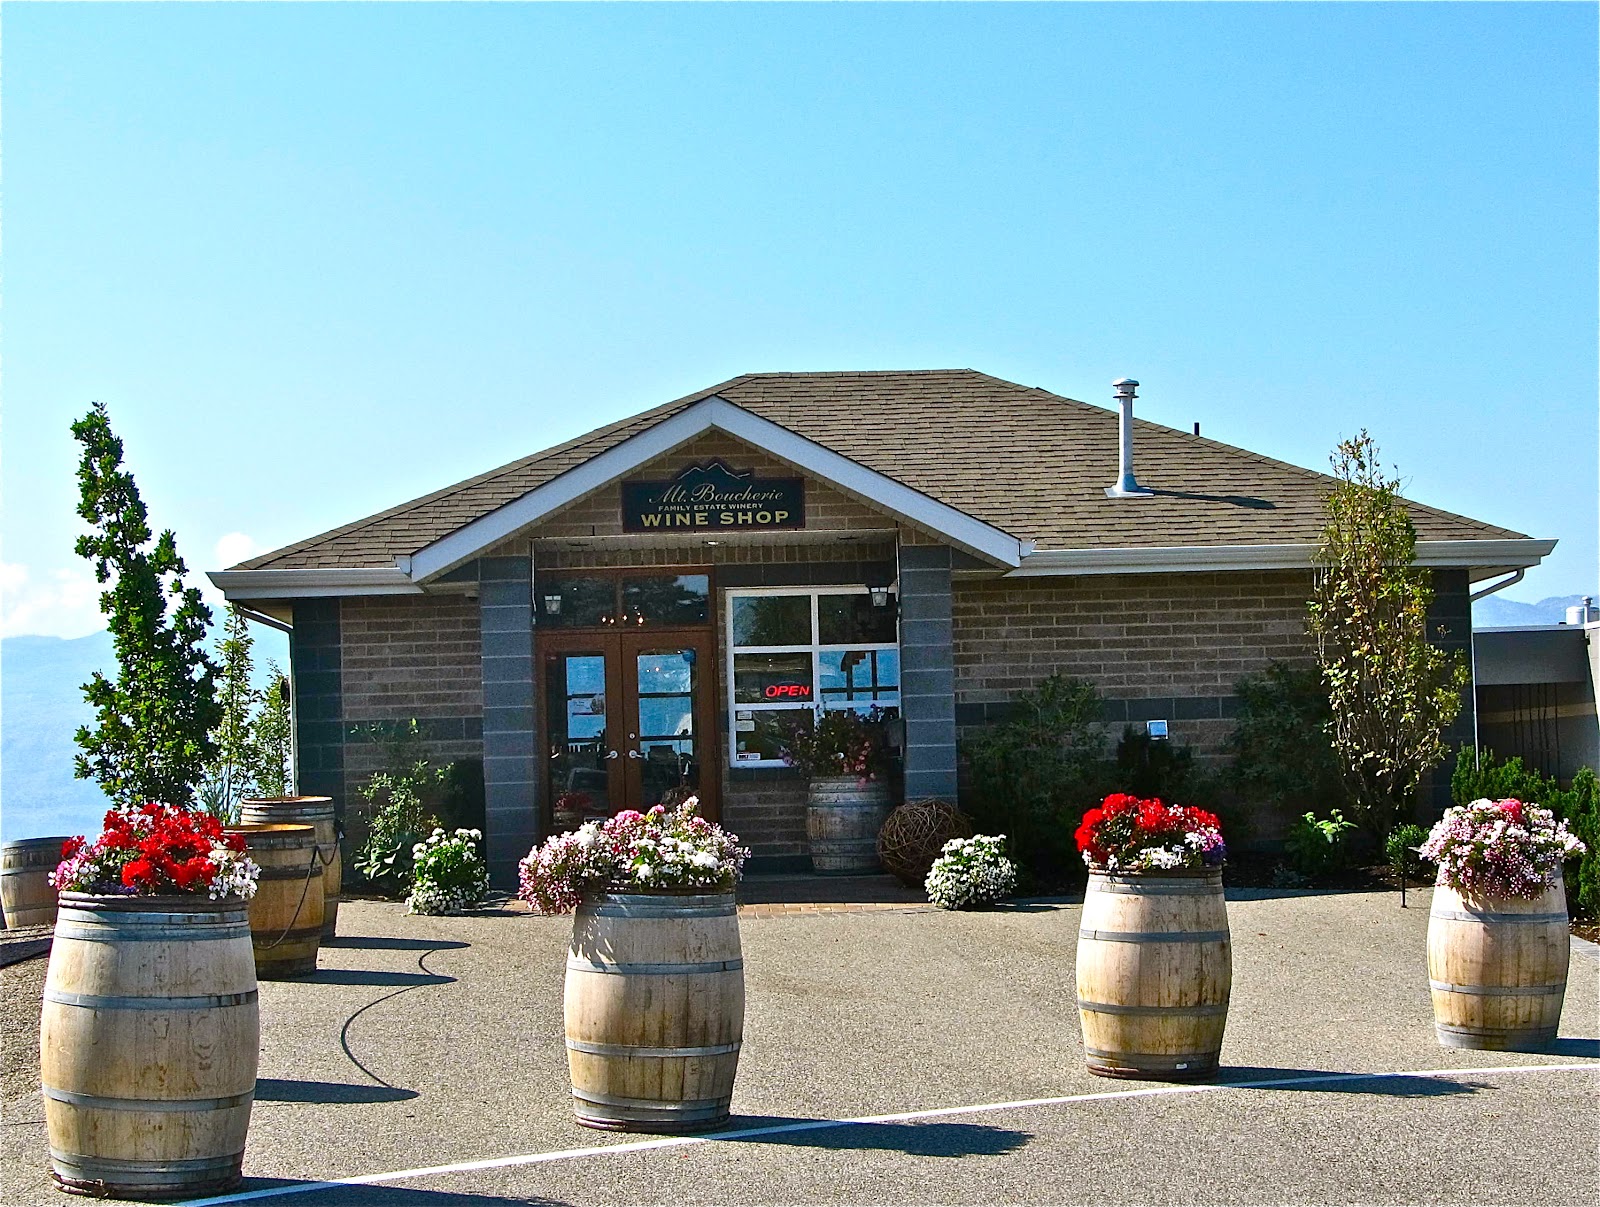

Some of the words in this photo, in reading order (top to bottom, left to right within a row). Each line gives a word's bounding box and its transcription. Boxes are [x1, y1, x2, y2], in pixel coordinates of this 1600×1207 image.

[649, 484, 686, 503] Mt.
[690, 483, 783, 502] Boucherie
[641, 512, 708, 527] WINE
[720, 510, 789, 525] SHOP
[765, 685, 810, 697] OPEN
